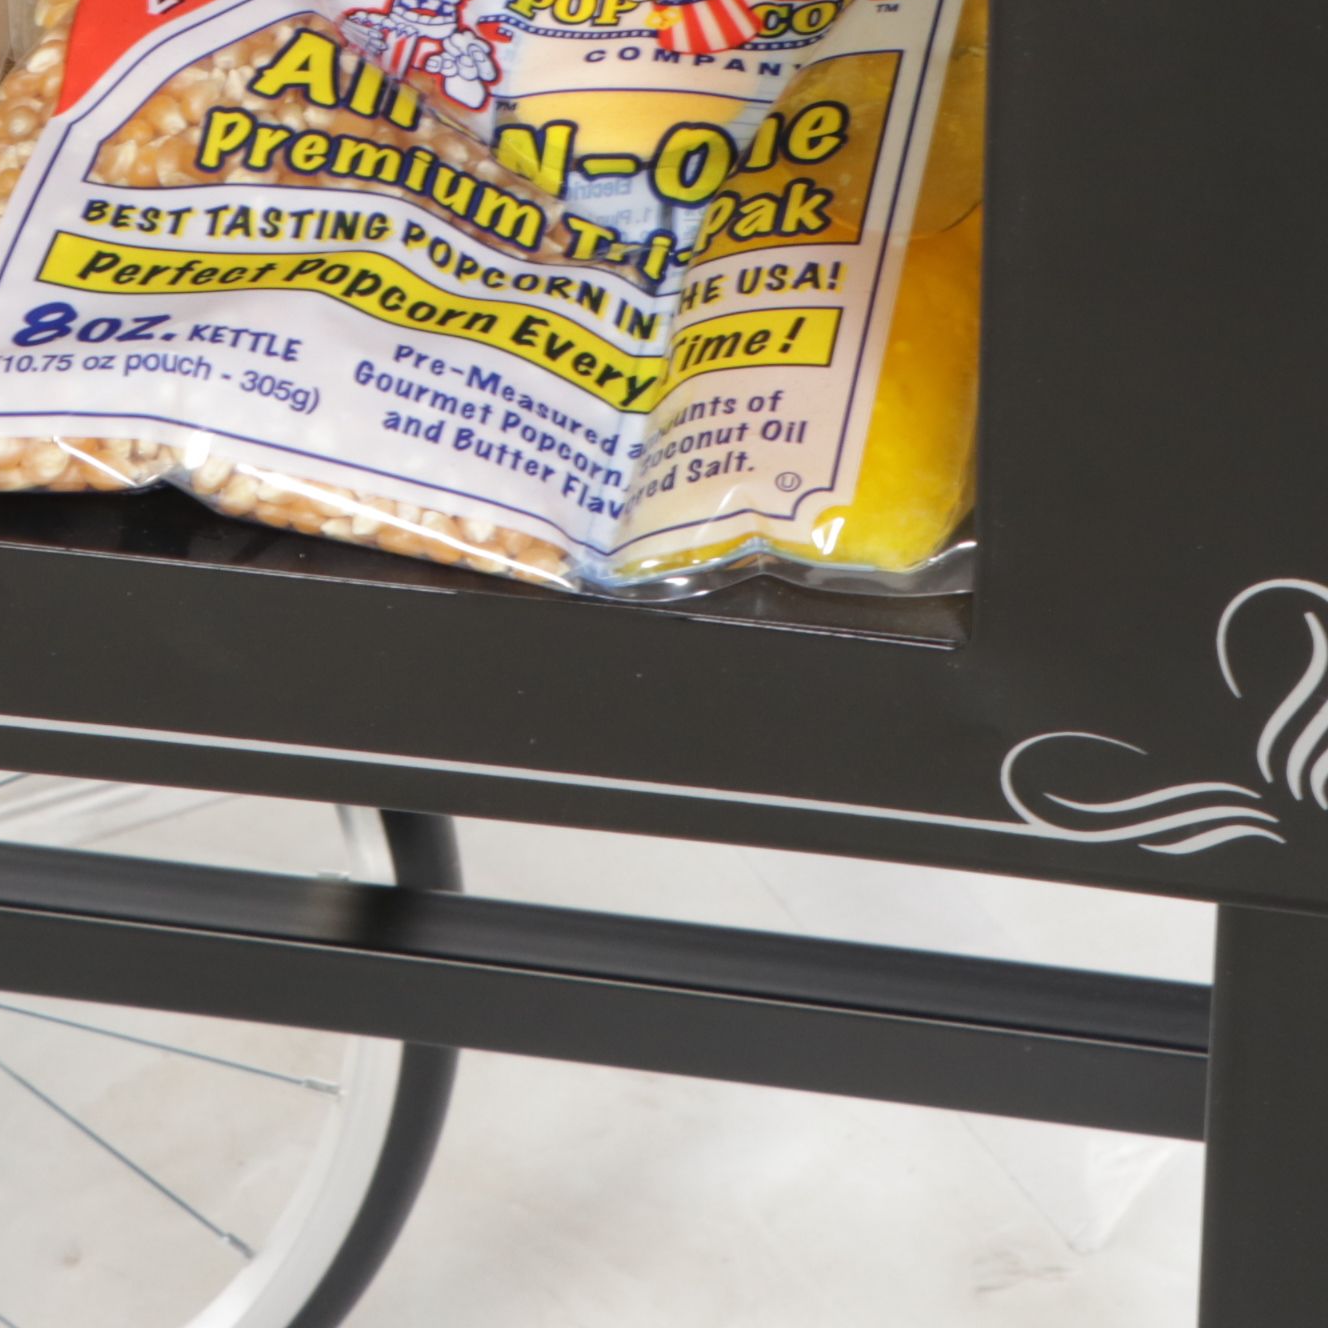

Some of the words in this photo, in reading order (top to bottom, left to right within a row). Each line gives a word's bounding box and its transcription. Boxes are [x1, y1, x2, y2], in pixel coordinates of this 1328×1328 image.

[583, 46, 801, 77] COMPAN
[194, 105, 546, 253] Premium
[81, 199, 196, 237] BEST
[204, 203, 394, 243] TASTING
[401, 219, 611, 318] POPCORN
[614, 297, 660, 342] IN
[737, 261, 847, 295] USA!
[77, 251, 276, 287] Perfect
[284, 258, 498, 334] Popcorn
[509, 313, 659, 408] Every
[187, 323, 303, 362] KETTLE
[82, 355, 116, 370] oz
[123, 352, 212, 380] pouch
[240, 370, 321, 415] 305g)
[353, 359, 494, 427] Gourmet
[761, 419, 809, 445] Oil
[393, 343, 620, 457] Pre-Measured
[748, 390, 784, 414] of
[382, 410, 447, 446] and
[452, 425, 558, 485] Butter
[686, 449, 756, 485] Salt.
